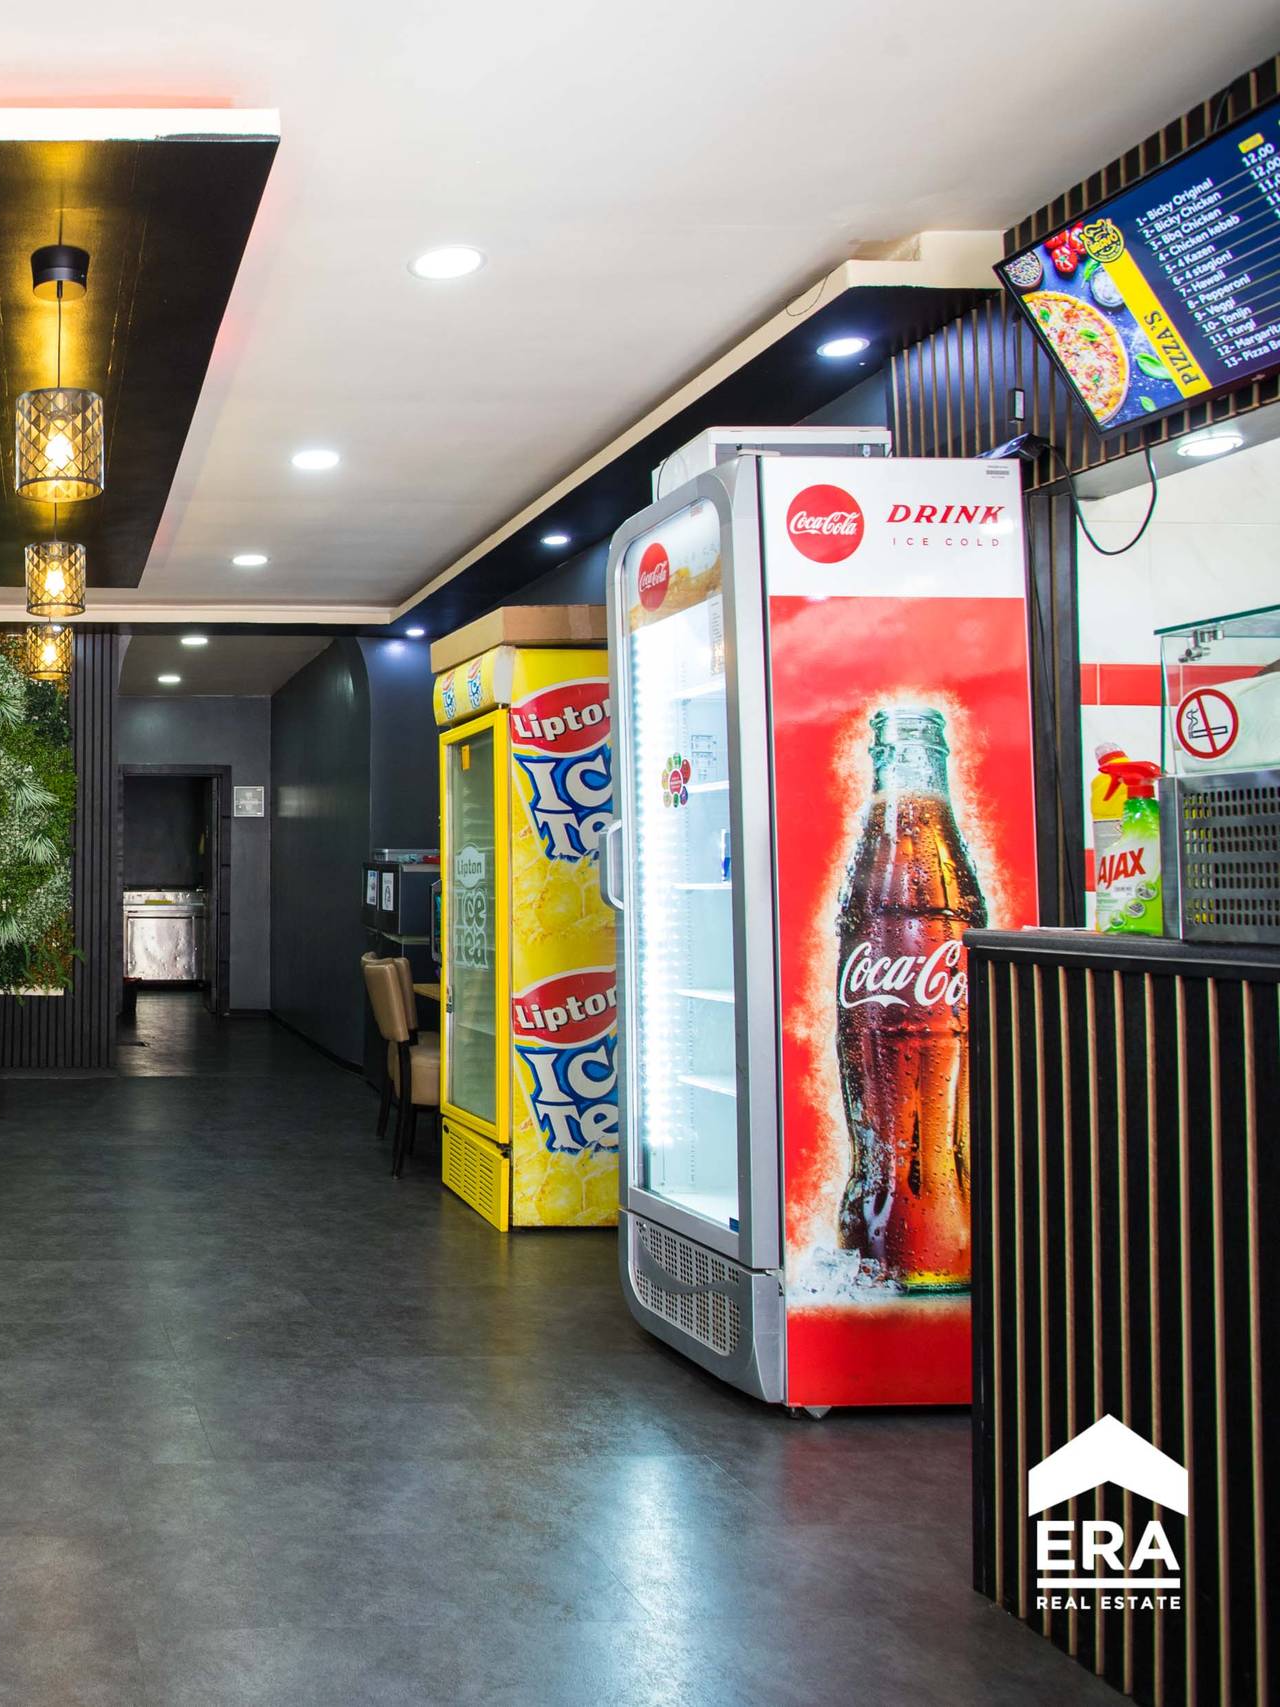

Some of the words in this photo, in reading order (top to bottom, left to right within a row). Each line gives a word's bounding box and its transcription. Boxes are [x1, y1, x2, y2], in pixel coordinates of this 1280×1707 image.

[1242, 143, 1275, 167] 12,00
[1146, 202, 1174, 220] Bicky
[1173, 178, 1213, 205] Original
[1154, 214, 1180, 232] Bicky
[1180, 192, 1222, 218] Chicken
[1161, 230, 1184, 244] Bbq
[1181, 208, 1222, 233] Chicken
[1169, 231, 1208, 256] Chicken
[1206, 214, 1240, 236] kebab
[1192, 250, 1232, 277] stagioni
[1190, 270, 1226, 292] Hawaii
[1198, 274, 1251, 304] Pepperoni
[1204, 296, 1236, 315] Veggi
[1218, 306, 1252, 324] Tonijn
[1226, 318, 1256, 337] Fungi
[1242, 344, 1270, 360] Pizza
[790, 511, 860, 536] Coca-Cola
[887, 504, 1006, 524] DRINK
[893, 538, 928, 546] ICE
[945, 538, 999, 547] COLD
[640, 560, 668, 592] Coca-Cola
[457, 860, 482, 878] Lipton
[1097, 848, 1146, 890] AJAX
[839, 940, 968, 1008] Coca-Co
[536, 1104, 618, 1150] Te
